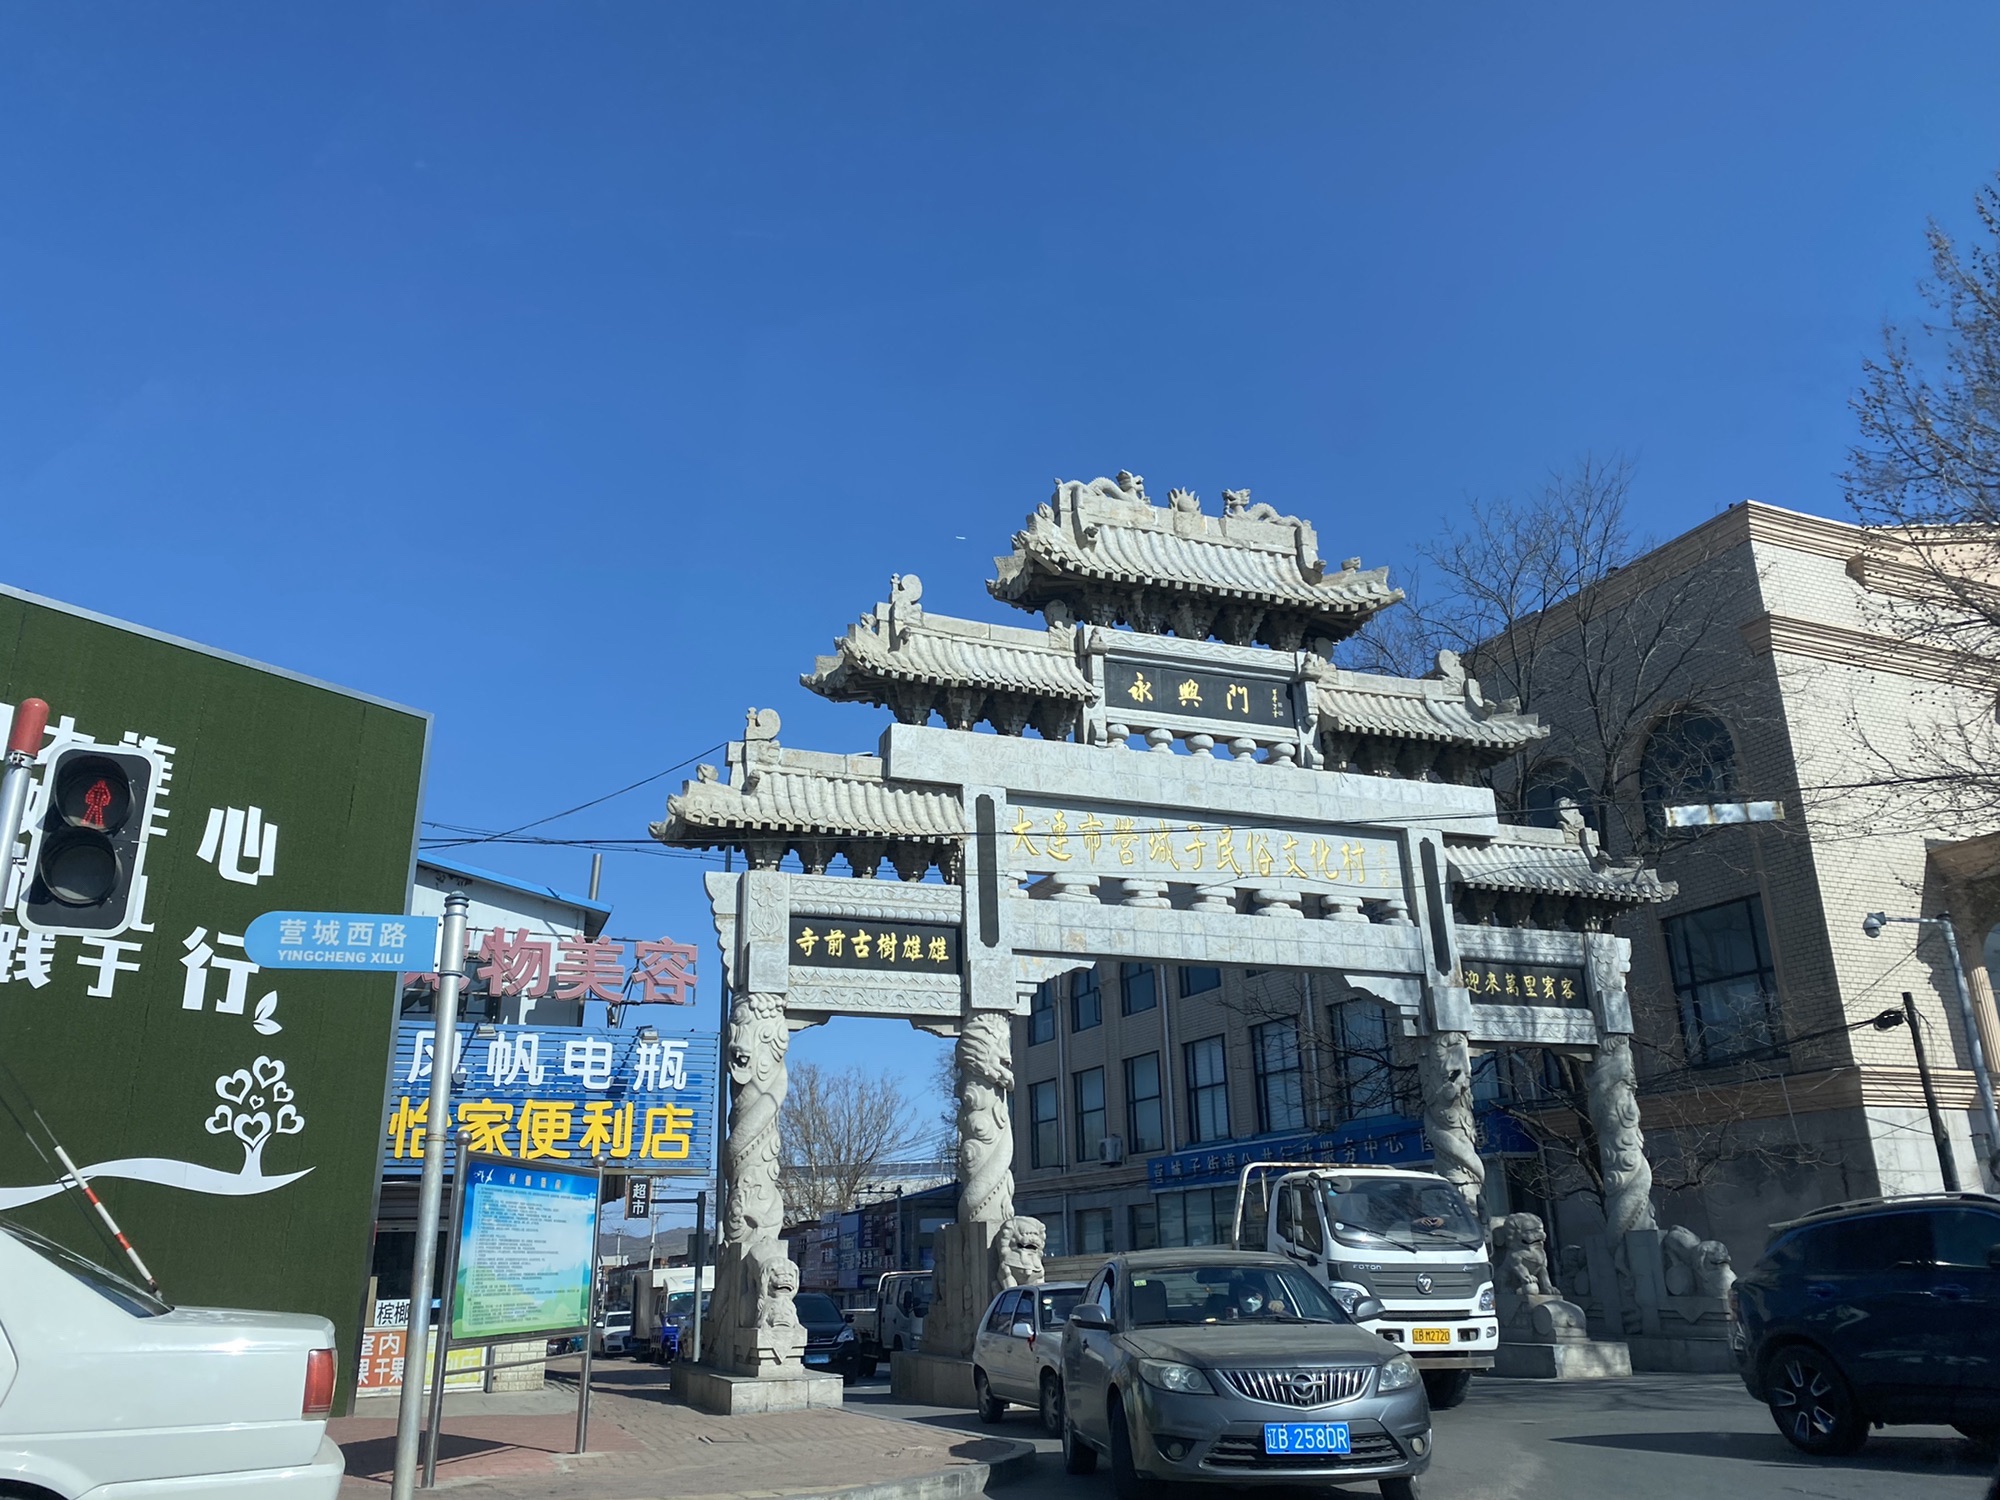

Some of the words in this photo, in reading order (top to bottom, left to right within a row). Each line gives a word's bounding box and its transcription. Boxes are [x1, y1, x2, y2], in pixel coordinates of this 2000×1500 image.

[279, 918, 408, 949] 营城西路
[278, 949, 367, 963] YINGCHENG
[371, 952, 405, 965] XILU
[632, 1183, 647, 1216] 超市
